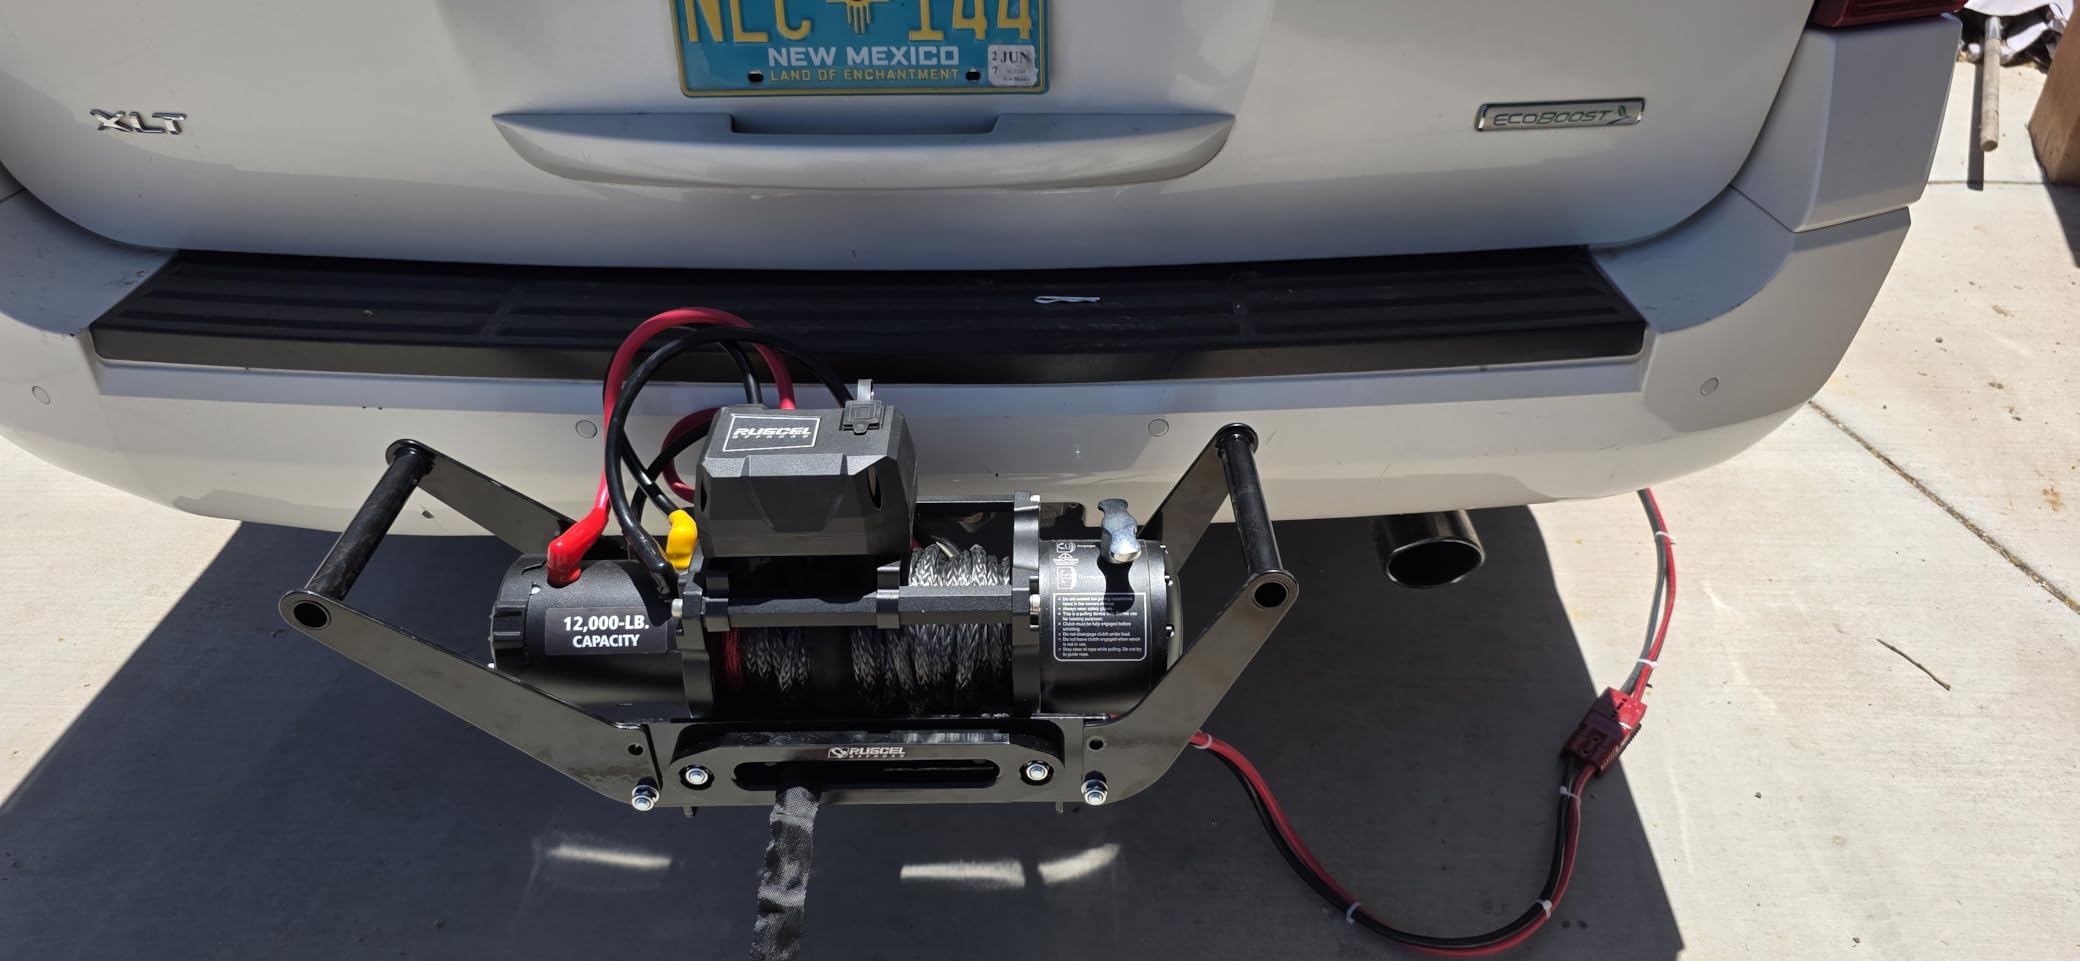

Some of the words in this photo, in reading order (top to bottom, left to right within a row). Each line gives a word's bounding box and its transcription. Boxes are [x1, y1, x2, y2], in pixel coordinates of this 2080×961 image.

[768, 47, 835, 67] NEW
[847, 46, 960, 66] MEXICO
[1001, 51, 1031, 63] JUN
[771, 69, 812, 82] LAND
[818, 69, 838, 81] OF
[844, 68, 959, 81] ENCHANTMENT
[90, 109, 187, 135] XLT
[733, 427, 811, 436] RUGCEL
[563, 615, 649, 633] 12,000-LB.
[572, 634, 640, 648] CAPACITY
[848, 746, 906, 755] RUGCEL
